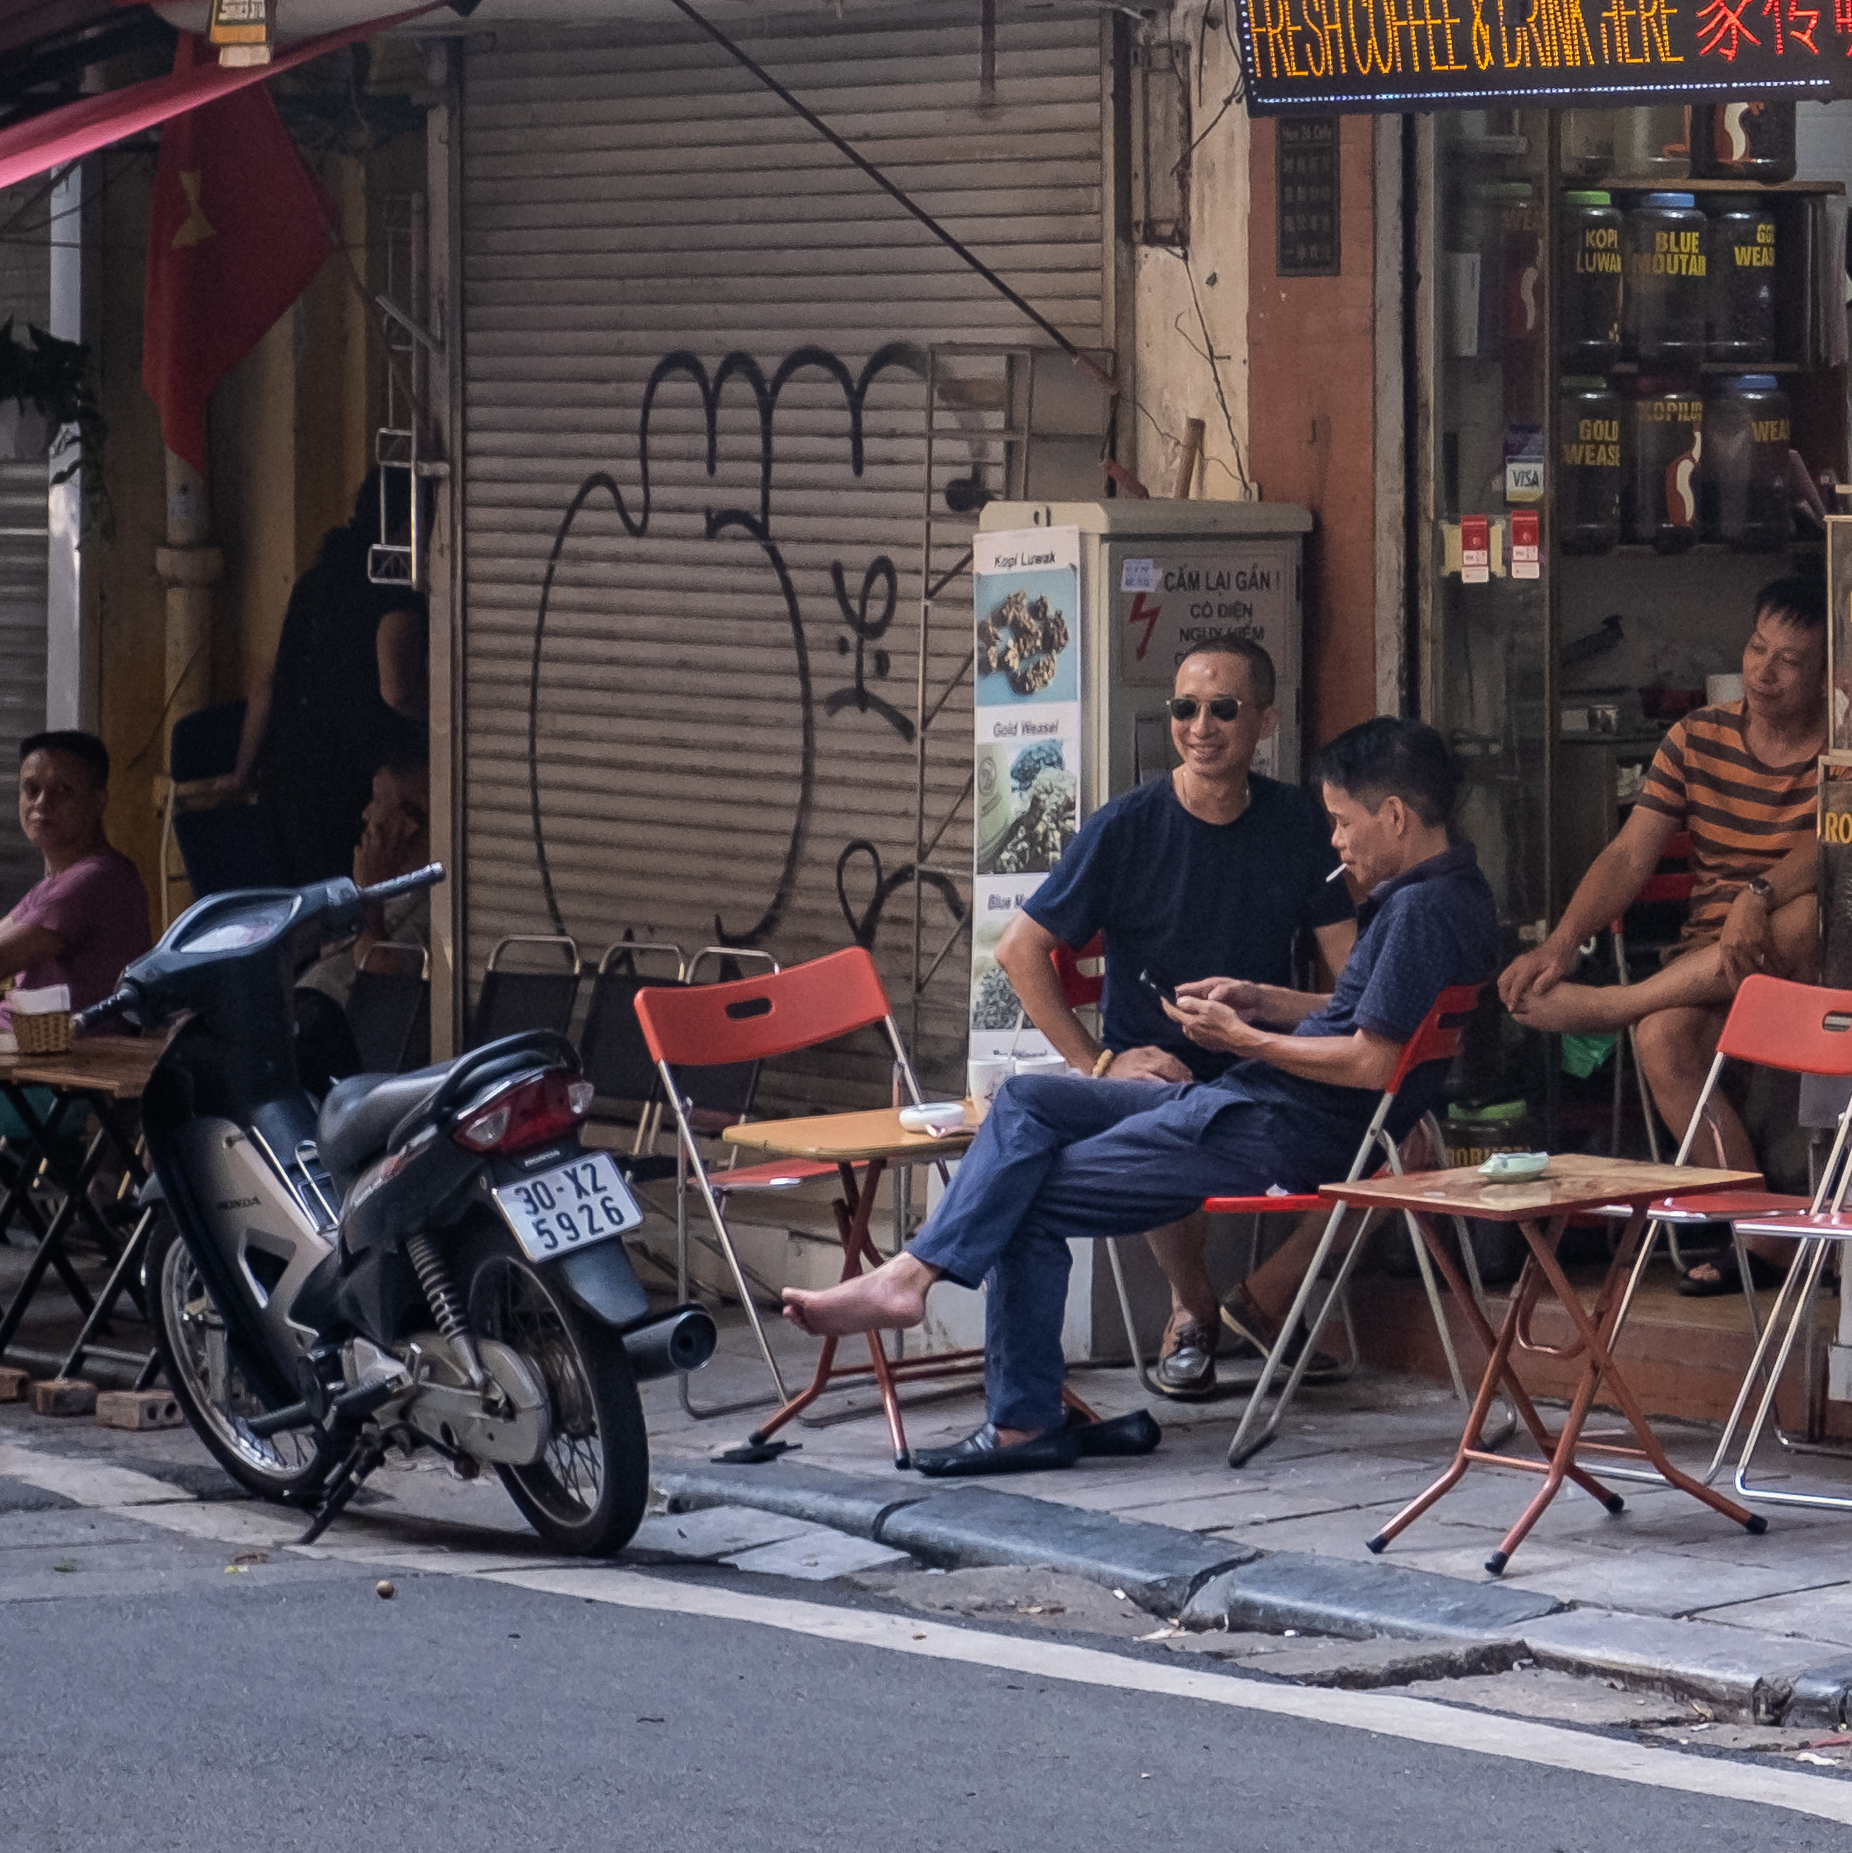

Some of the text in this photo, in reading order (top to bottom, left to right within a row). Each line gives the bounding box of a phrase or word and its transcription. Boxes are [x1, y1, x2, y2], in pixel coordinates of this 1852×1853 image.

[1585, 228, 1618, 249] KOPI
[1654, 230, 1700, 255] BLUE
[1512, 469, 1539, 487] VISA
[514, 1161, 608, 1216] 30-X2
[531, 1195, 625, 1250] 5926
